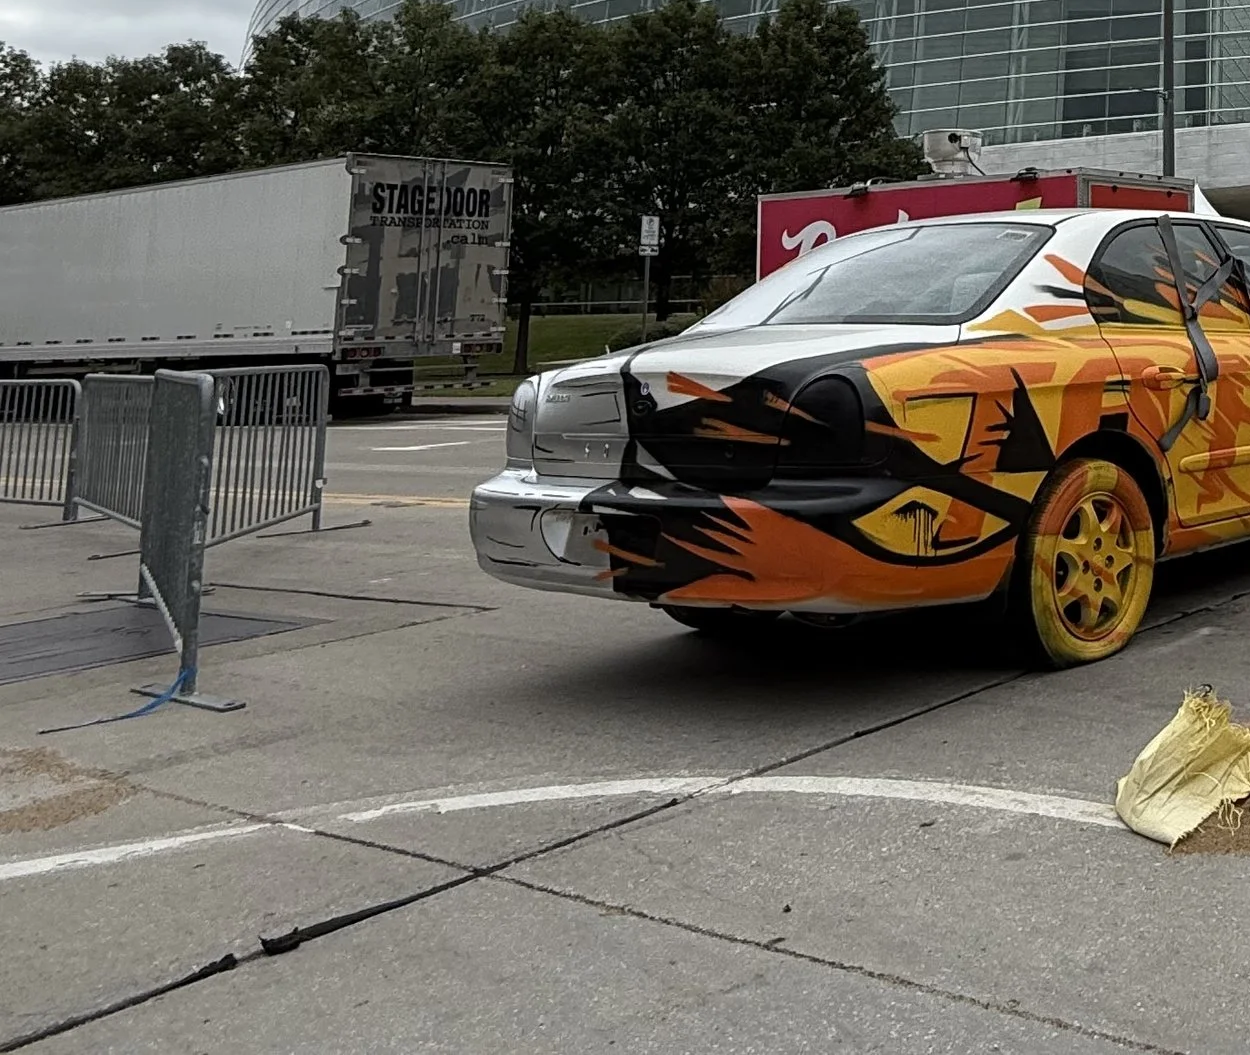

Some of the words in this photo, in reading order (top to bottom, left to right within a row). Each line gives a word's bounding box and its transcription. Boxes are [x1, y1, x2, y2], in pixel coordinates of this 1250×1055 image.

[371, 182, 437, 216] STAGE
[438, 186, 490, 217] DOOR
[370, 215, 489, 230] TRANSPORTATION
